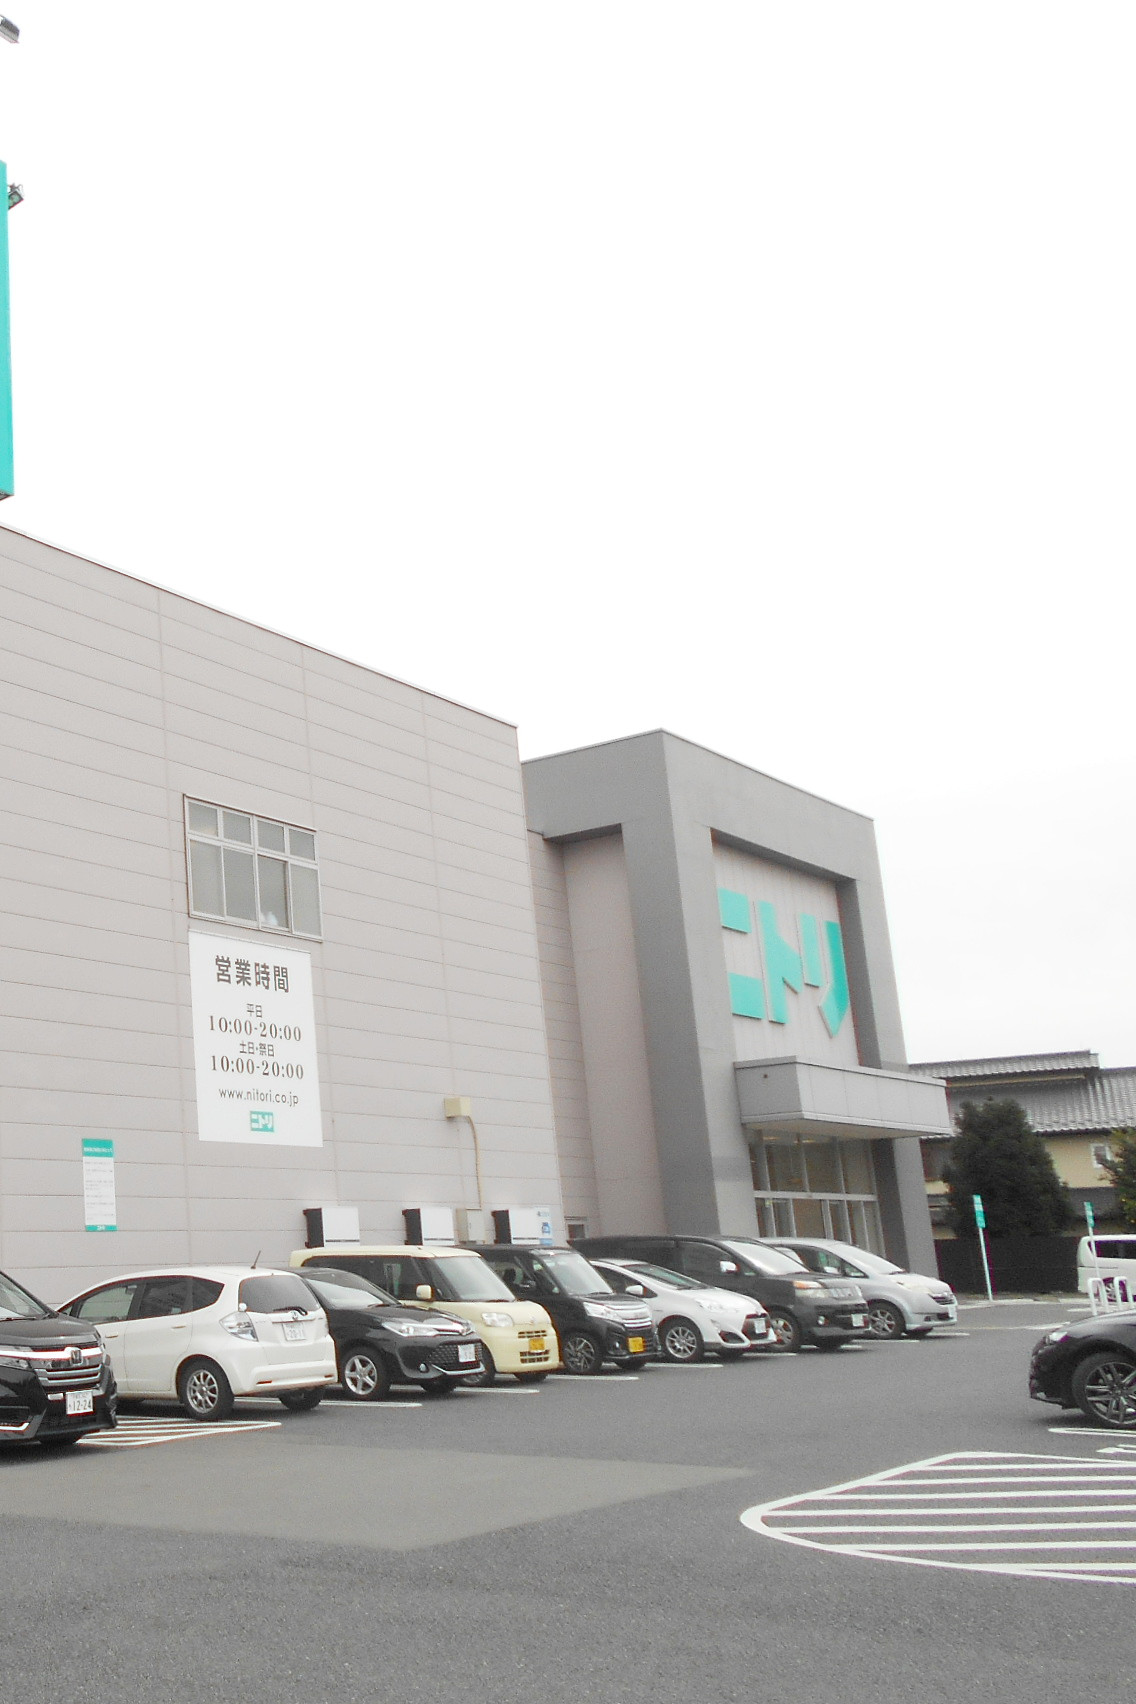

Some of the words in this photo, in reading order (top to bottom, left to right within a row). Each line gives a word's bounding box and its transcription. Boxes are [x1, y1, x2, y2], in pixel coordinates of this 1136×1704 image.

[214, 954, 290, 993] 営業時間
[717, 887, 852, 1038] ニトリ
[246, 1003, 263, 1018] 平日
[208, 1015, 302, 1041] 10:00-20:00
[210, 1055, 304, 1080] 10:00-20:00
[218, 1088, 300, 1107] www.nitori.co.jp
